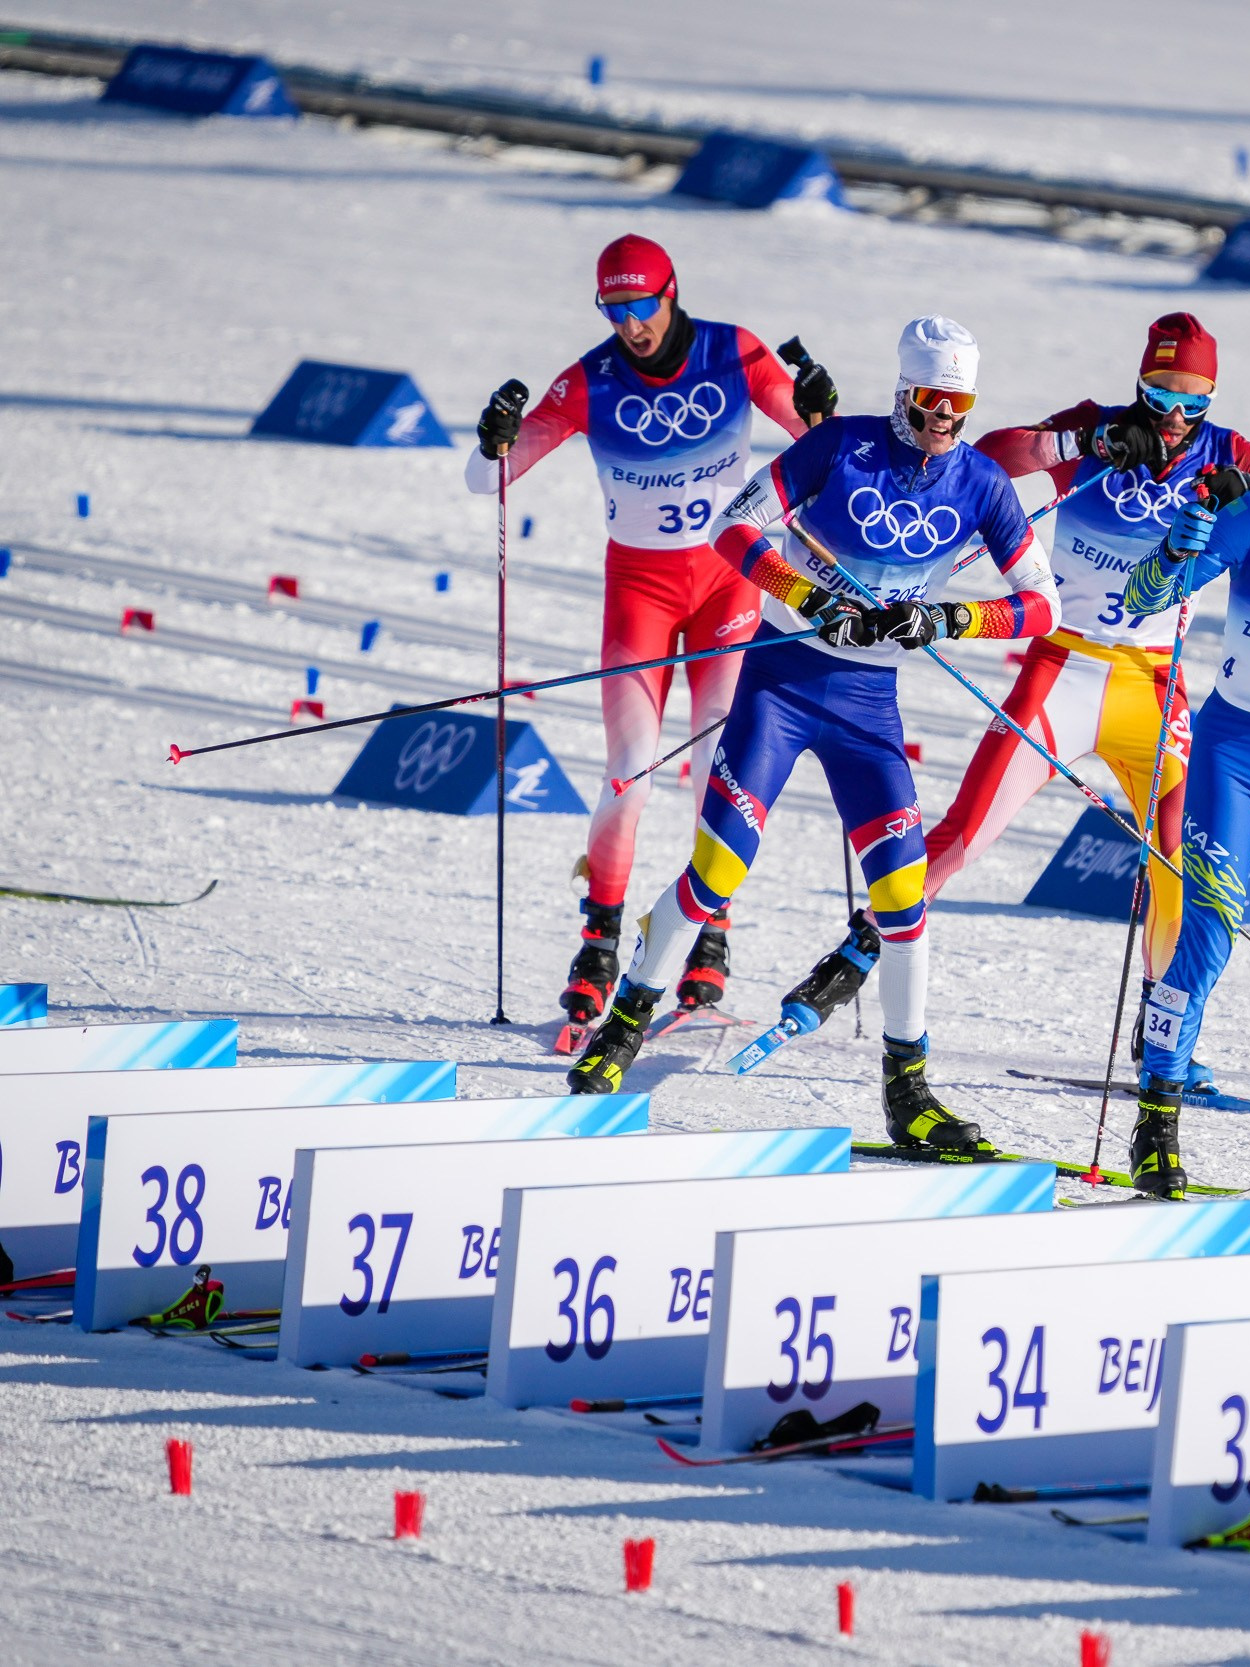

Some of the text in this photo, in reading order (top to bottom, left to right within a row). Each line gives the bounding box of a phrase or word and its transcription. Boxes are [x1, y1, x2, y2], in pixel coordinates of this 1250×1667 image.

[603, 273, 647, 288] SUISSE
[611, 451, 741, 491] BEIJING 2022
[657, 498, 712, 534] 39
[715, 609, 756, 637] odlo
[719, 763, 759, 829] sportful
[1184, 815, 1231, 864] KAZ
[1148, 1012, 1172, 1037] 34
[940, 1153, 974, 1163] FISCHER
[132, 1163, 206, 1268] 38
[339, 1212, 414, 1317] 37
[170, 1299, 200, 1319] LEKI
[545, 1255, 618, 1363] 36
[765, 1294, 838, 1402] 35
[976, 1326, 1048, 1434] 34
